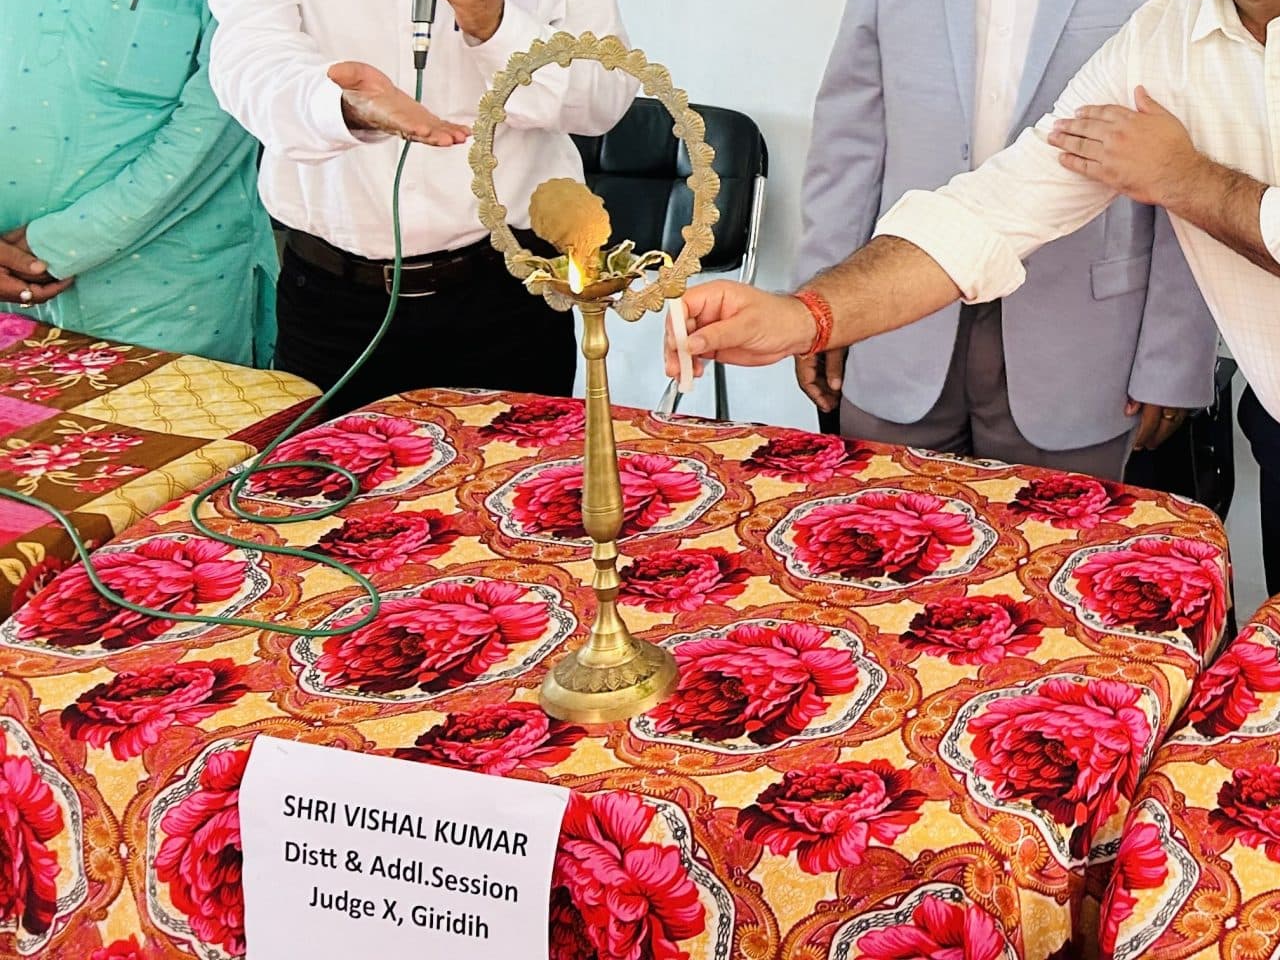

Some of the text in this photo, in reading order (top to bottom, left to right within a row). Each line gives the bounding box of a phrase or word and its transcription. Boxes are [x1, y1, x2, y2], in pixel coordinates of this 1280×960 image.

[283, 795, 528, 857] SHRI VISHAL KUMAR
[284, 841, 519, 903] Distt & Addl.Session
[309, 887, 489, 939] Judge X, Giridih
